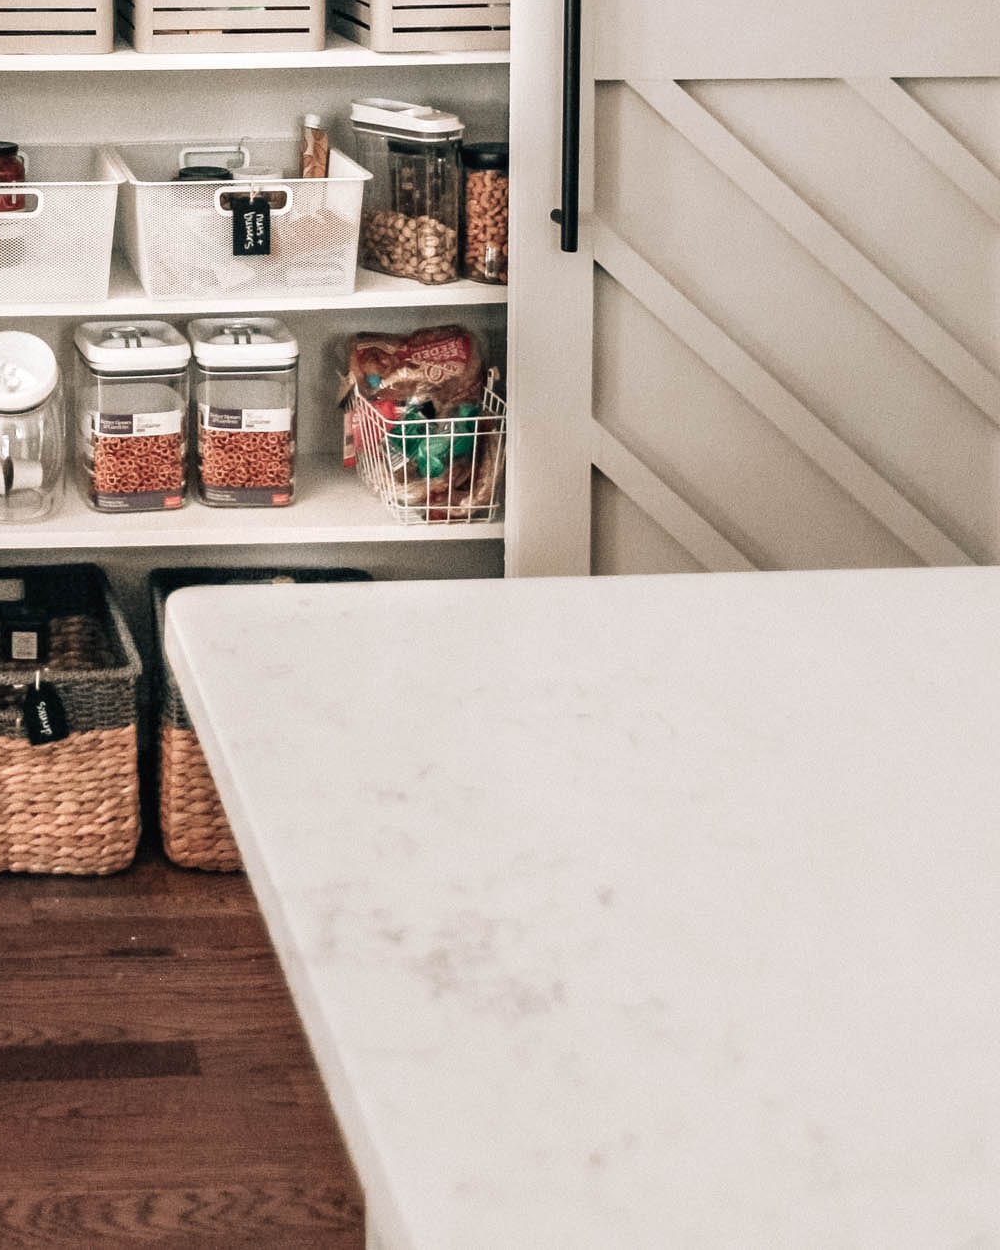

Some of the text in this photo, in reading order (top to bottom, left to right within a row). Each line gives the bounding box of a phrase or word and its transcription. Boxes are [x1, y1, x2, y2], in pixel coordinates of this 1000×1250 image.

[243, 211, 255, 250] butters
[256, 213, 264, 235] nuts
[37, 701, 53, 736] drinks
